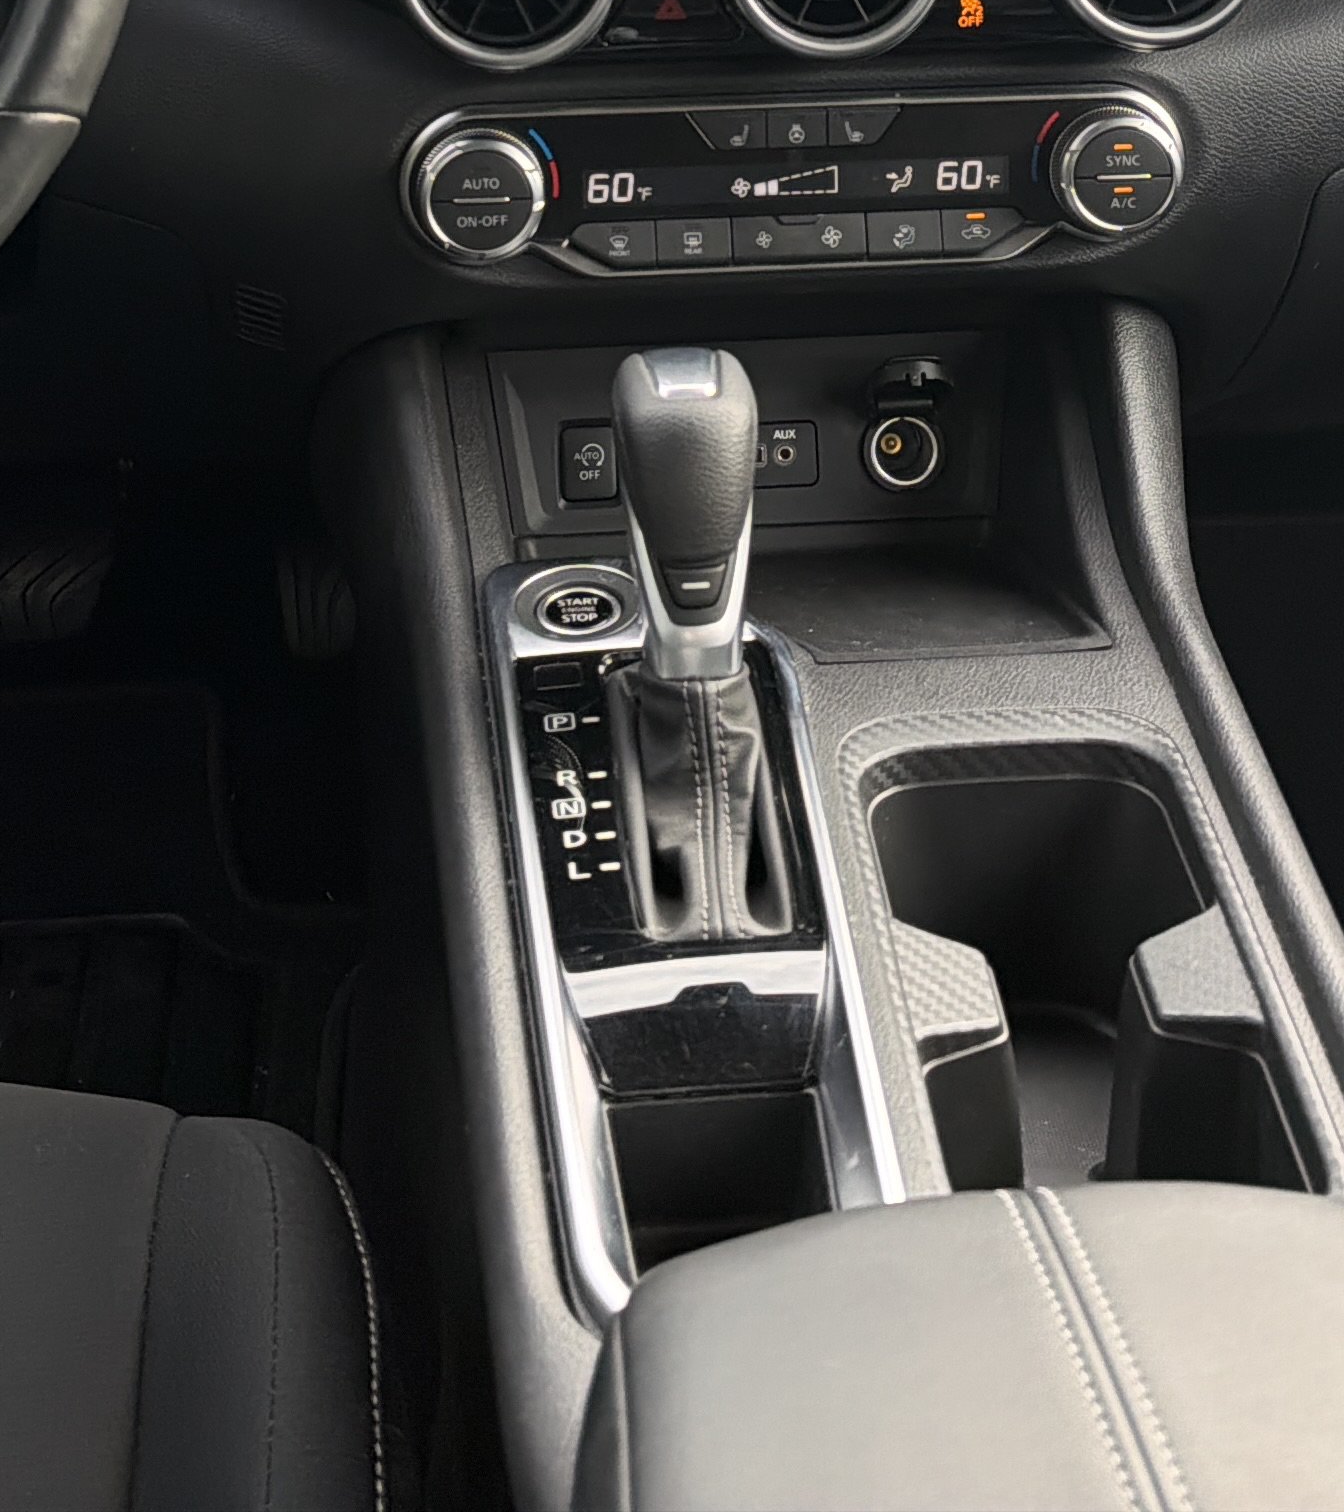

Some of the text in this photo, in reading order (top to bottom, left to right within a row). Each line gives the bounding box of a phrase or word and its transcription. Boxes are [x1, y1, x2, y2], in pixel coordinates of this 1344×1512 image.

[958, 15, 984, 28] OFF
[1106, 154, 1141, 167] SYNC
[462, 177, 500, 190] AUTO
[1110, 197, 1136, 209] A/C
[456, 215, 509, 229] ON-OFF
[773, 429, 796, 440] AUX
[574, 451, 600, 462] AUTO
[579, 470, 600, 481] OFF
[557, 597, 599, 608] START
[560, 612, 599, 624] STOP
[552, 716, 569, 729] P
[556, 770, 577, 787] R
[563, 830, 587, 849] D
[568, 861, 592, 881] L
